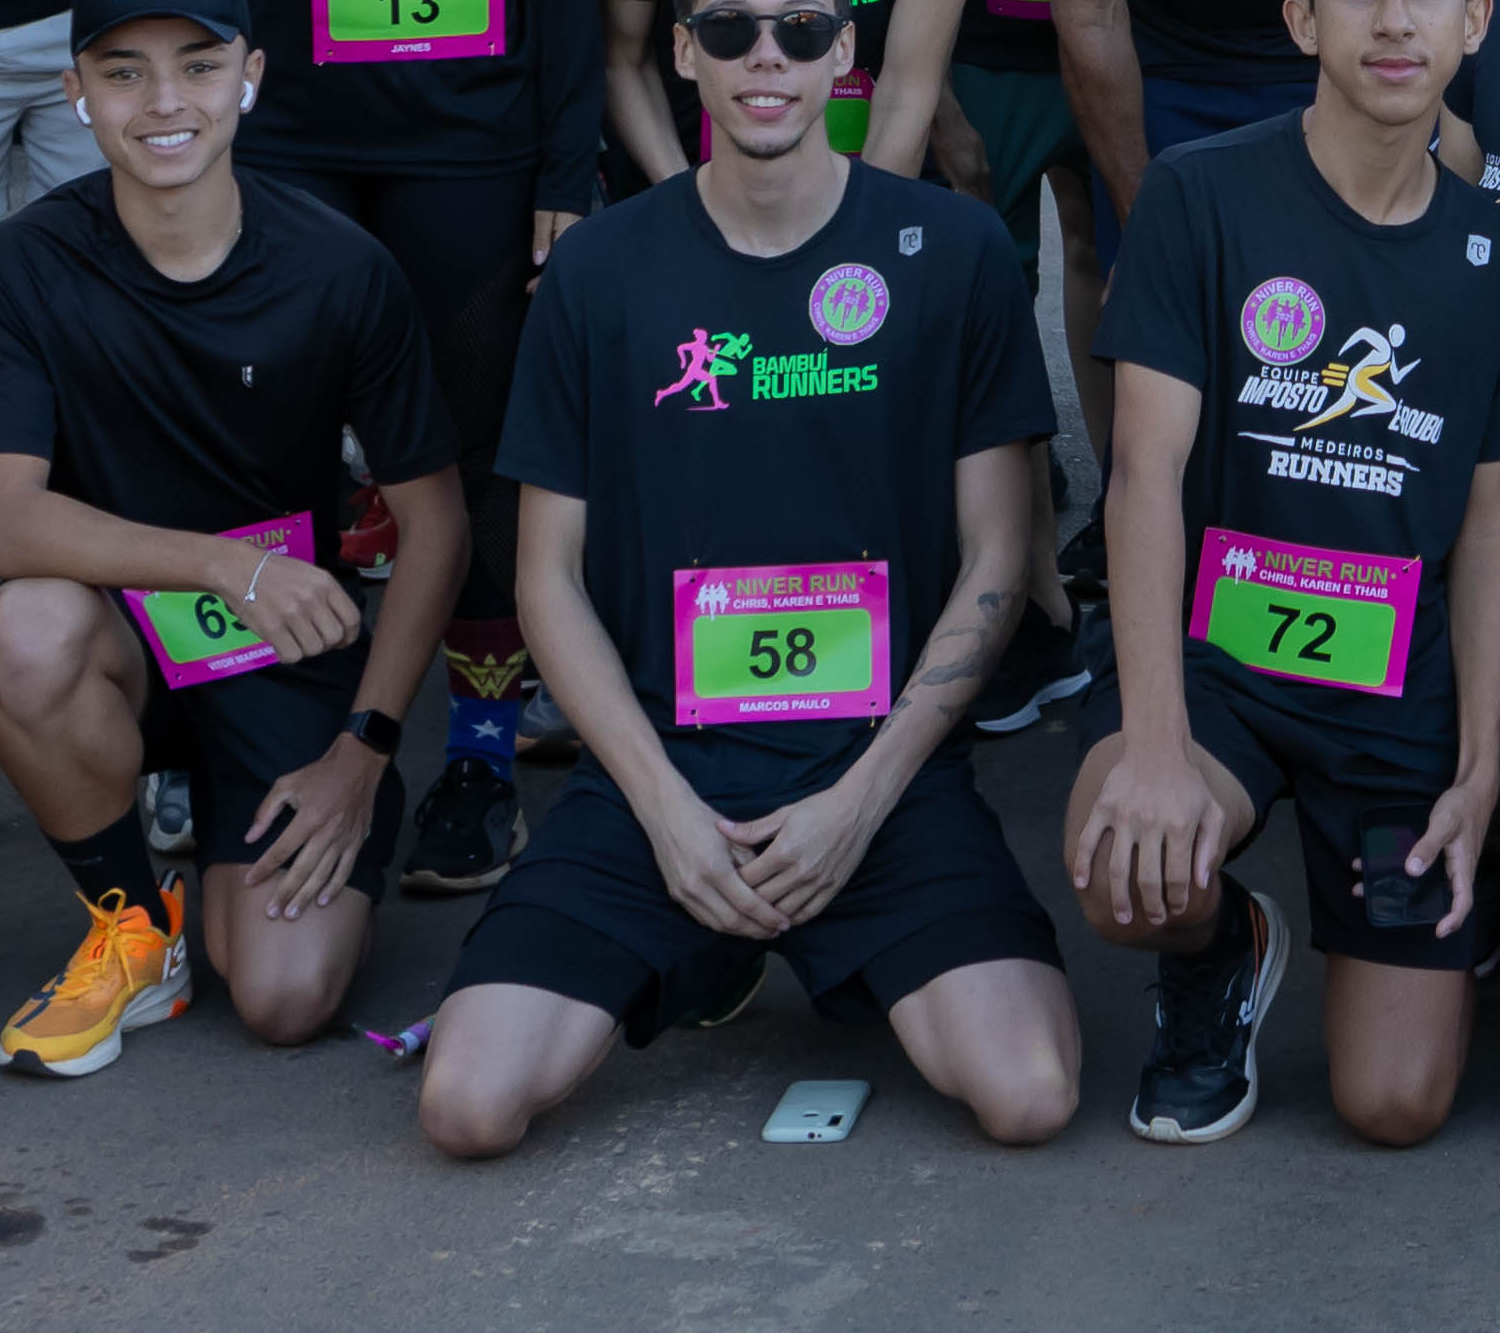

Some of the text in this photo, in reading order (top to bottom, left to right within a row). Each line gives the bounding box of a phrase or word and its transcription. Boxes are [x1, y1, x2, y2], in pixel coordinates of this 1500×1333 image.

[826, 266, 885, 298] NIVER RUN
[1256, 280, 1320, 312] NIVER RUN
[752, 347, 828, 375] BAMBUÍ
[1260, 366, 1320, 384] EQUIPE
[752, 363, 879, 400] RUNNERS
[1237, 378, 1329, 415] IMPOSTO
[1400, 408, 1445, 445] ROUBO
[1300, 436, 1384, 461] MEDEIROS
[1267, 450, 1404, 497] RUNNERS
[1264, 549, 1390, 584] NIVER RUN
[736, 572, 857, 595] NIVER RUN
[1258, 569, 1389, 599] CHRIS, KAREN THAIS
[733, 593, 860, 609] CHRIS, KAREN THAIS
[1266, 603, 1338, 664] 72
[748, 626, 817, 680] 58
[739, 698, 830, 713] MARCOS PAULO
